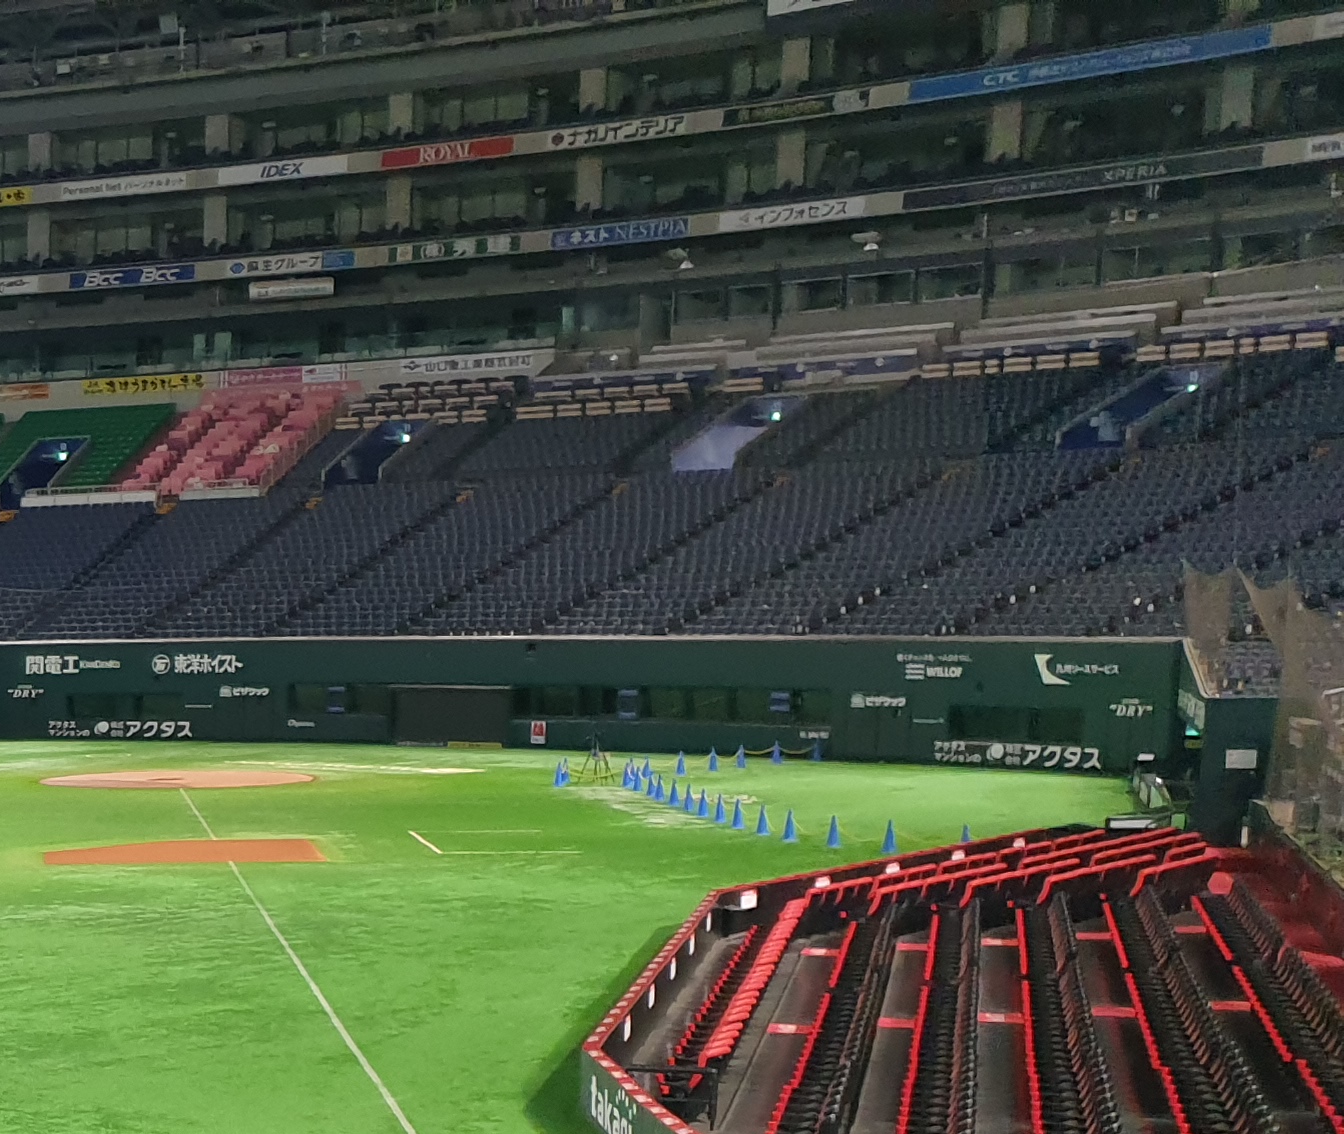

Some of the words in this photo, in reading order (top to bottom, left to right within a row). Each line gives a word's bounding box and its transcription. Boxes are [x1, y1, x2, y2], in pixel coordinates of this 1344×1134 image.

[419, 143, 471, 164] ROYAL
[260, 162, 304, 178] IDEX
[247, 256, 321, 273] 麻生グループ
[25, 655, 80, 675] 関電工
[125, 720, 193, 738] アクタス
[1021, 743, 1102, 770] アクタス
